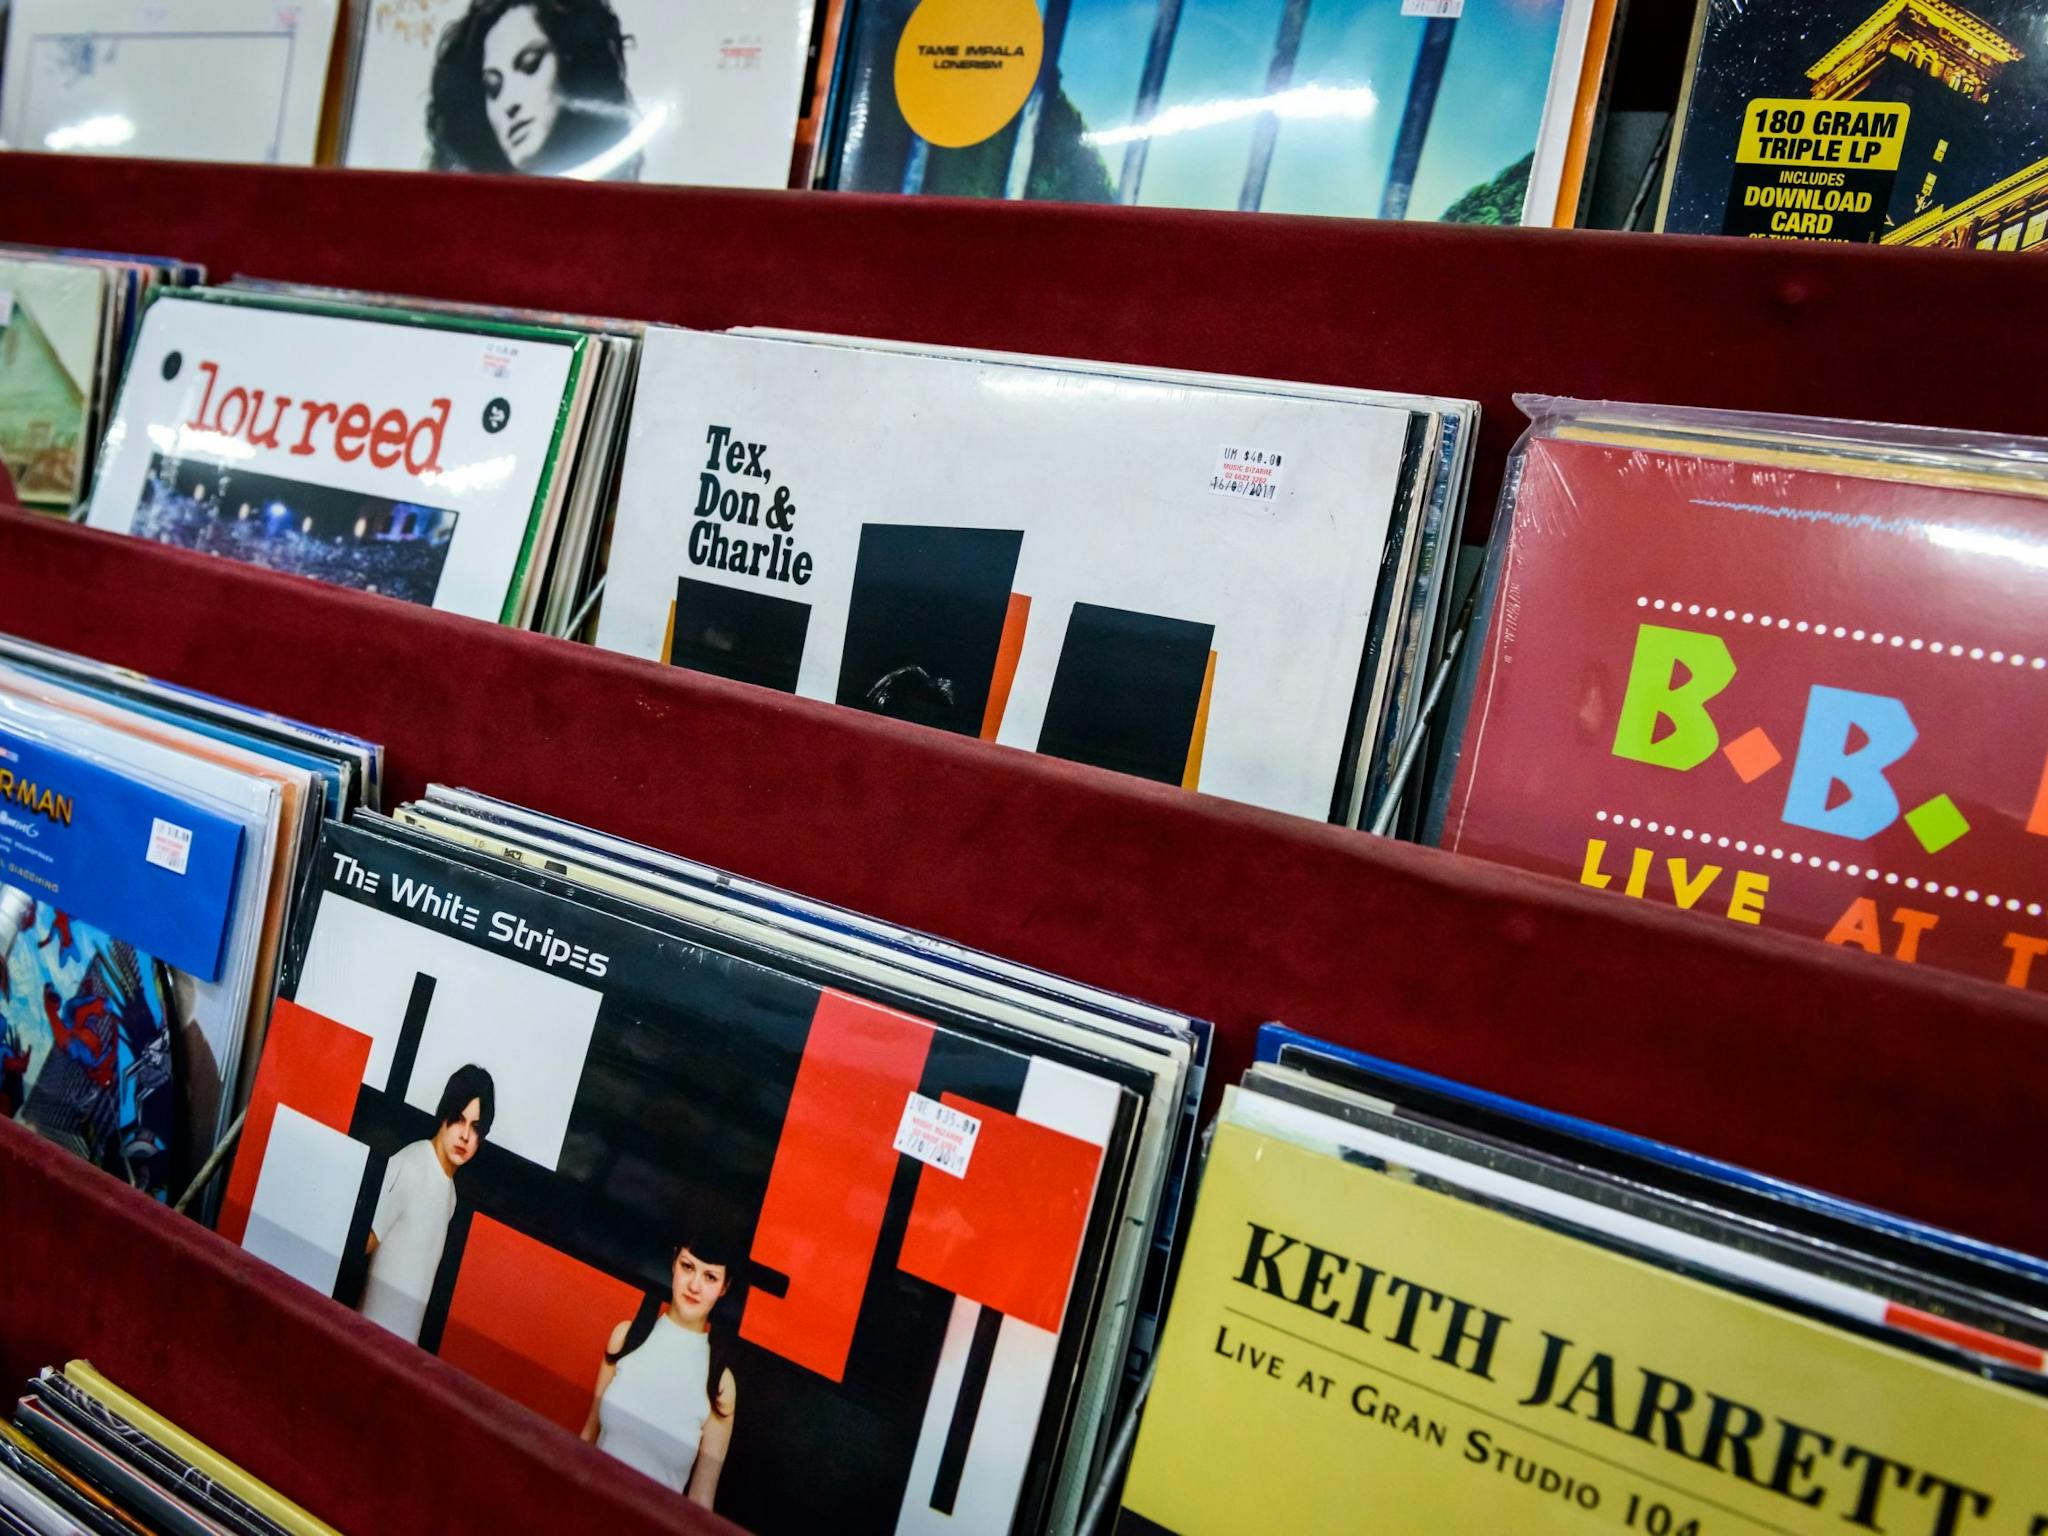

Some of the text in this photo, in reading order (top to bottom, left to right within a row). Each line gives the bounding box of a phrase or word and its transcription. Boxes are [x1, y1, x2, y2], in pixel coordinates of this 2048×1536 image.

[917, 45, 1025, 57] TAME IMPALA
[933, 59, 1003, 70] LONERISM
[1755, 109, 1899, 138] 180 GRAM
[1758, 137, 1882, 163] TRIPLE LP
[1778, 170, 1845, 187] INCLUDES
[1743, 186, 1873, 213] DOWNLOAD
[1770, 210, 1834, 235] CARD
[185, 360, 452, 477] lou reed
[706, 424, 772, 485] Tex,
[1224, 447, 1238, 460] UM
[1245, 466, 1273, 476] BIZARRE
[693, 471, 796, 532] Don &
[688, 519, 813, 586] Charlie
[1580, 838, 1771, 926] LIVE
[1824, 896, 1940, 964] AT
[391, 872, 481, 931] White
[487, 910, 611, 978] Stripes
[1232, 1221, 1995, 1536] KEITH JARRETT
